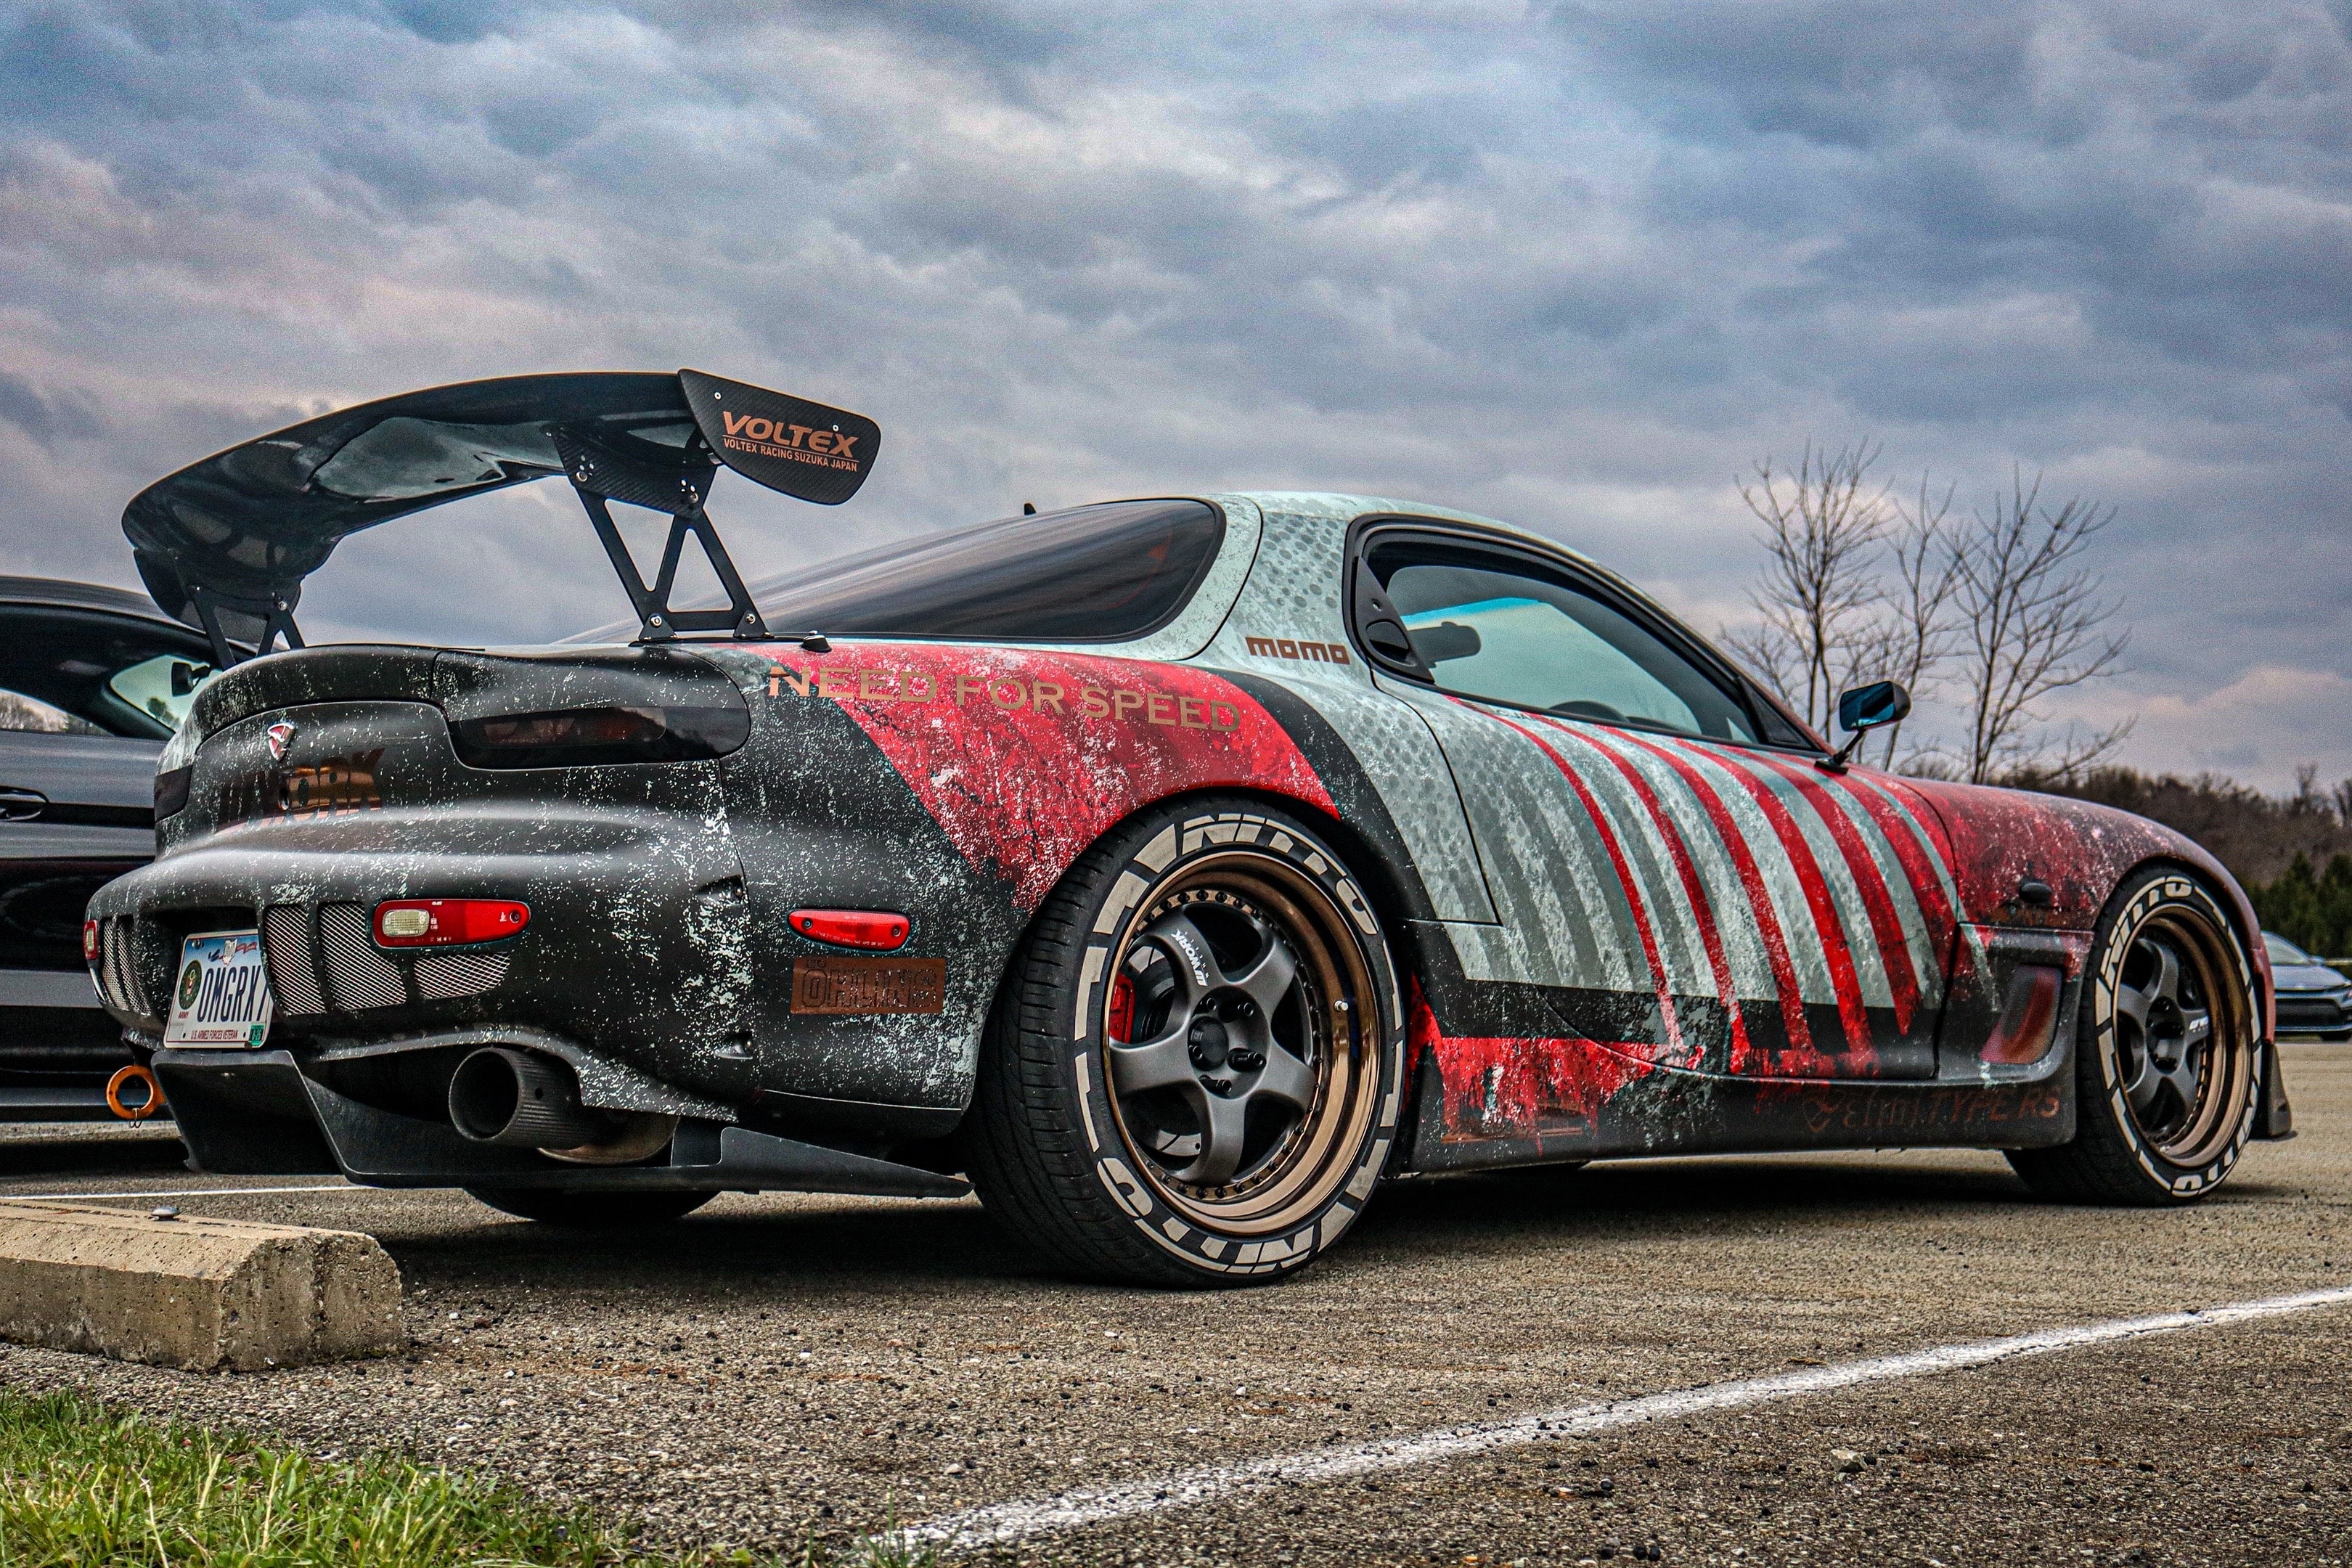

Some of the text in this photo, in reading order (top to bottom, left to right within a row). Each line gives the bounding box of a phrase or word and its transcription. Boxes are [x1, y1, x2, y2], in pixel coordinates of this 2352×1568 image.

[722, 411, 858, 458] VOLTEX
[724, 438, 858, 472] VOLTEX RACING SUZUKA JAPAN
[767, 666, 1239, 733] NEED FOR SPEED
[1170, 928, 1201, 971] WORK
